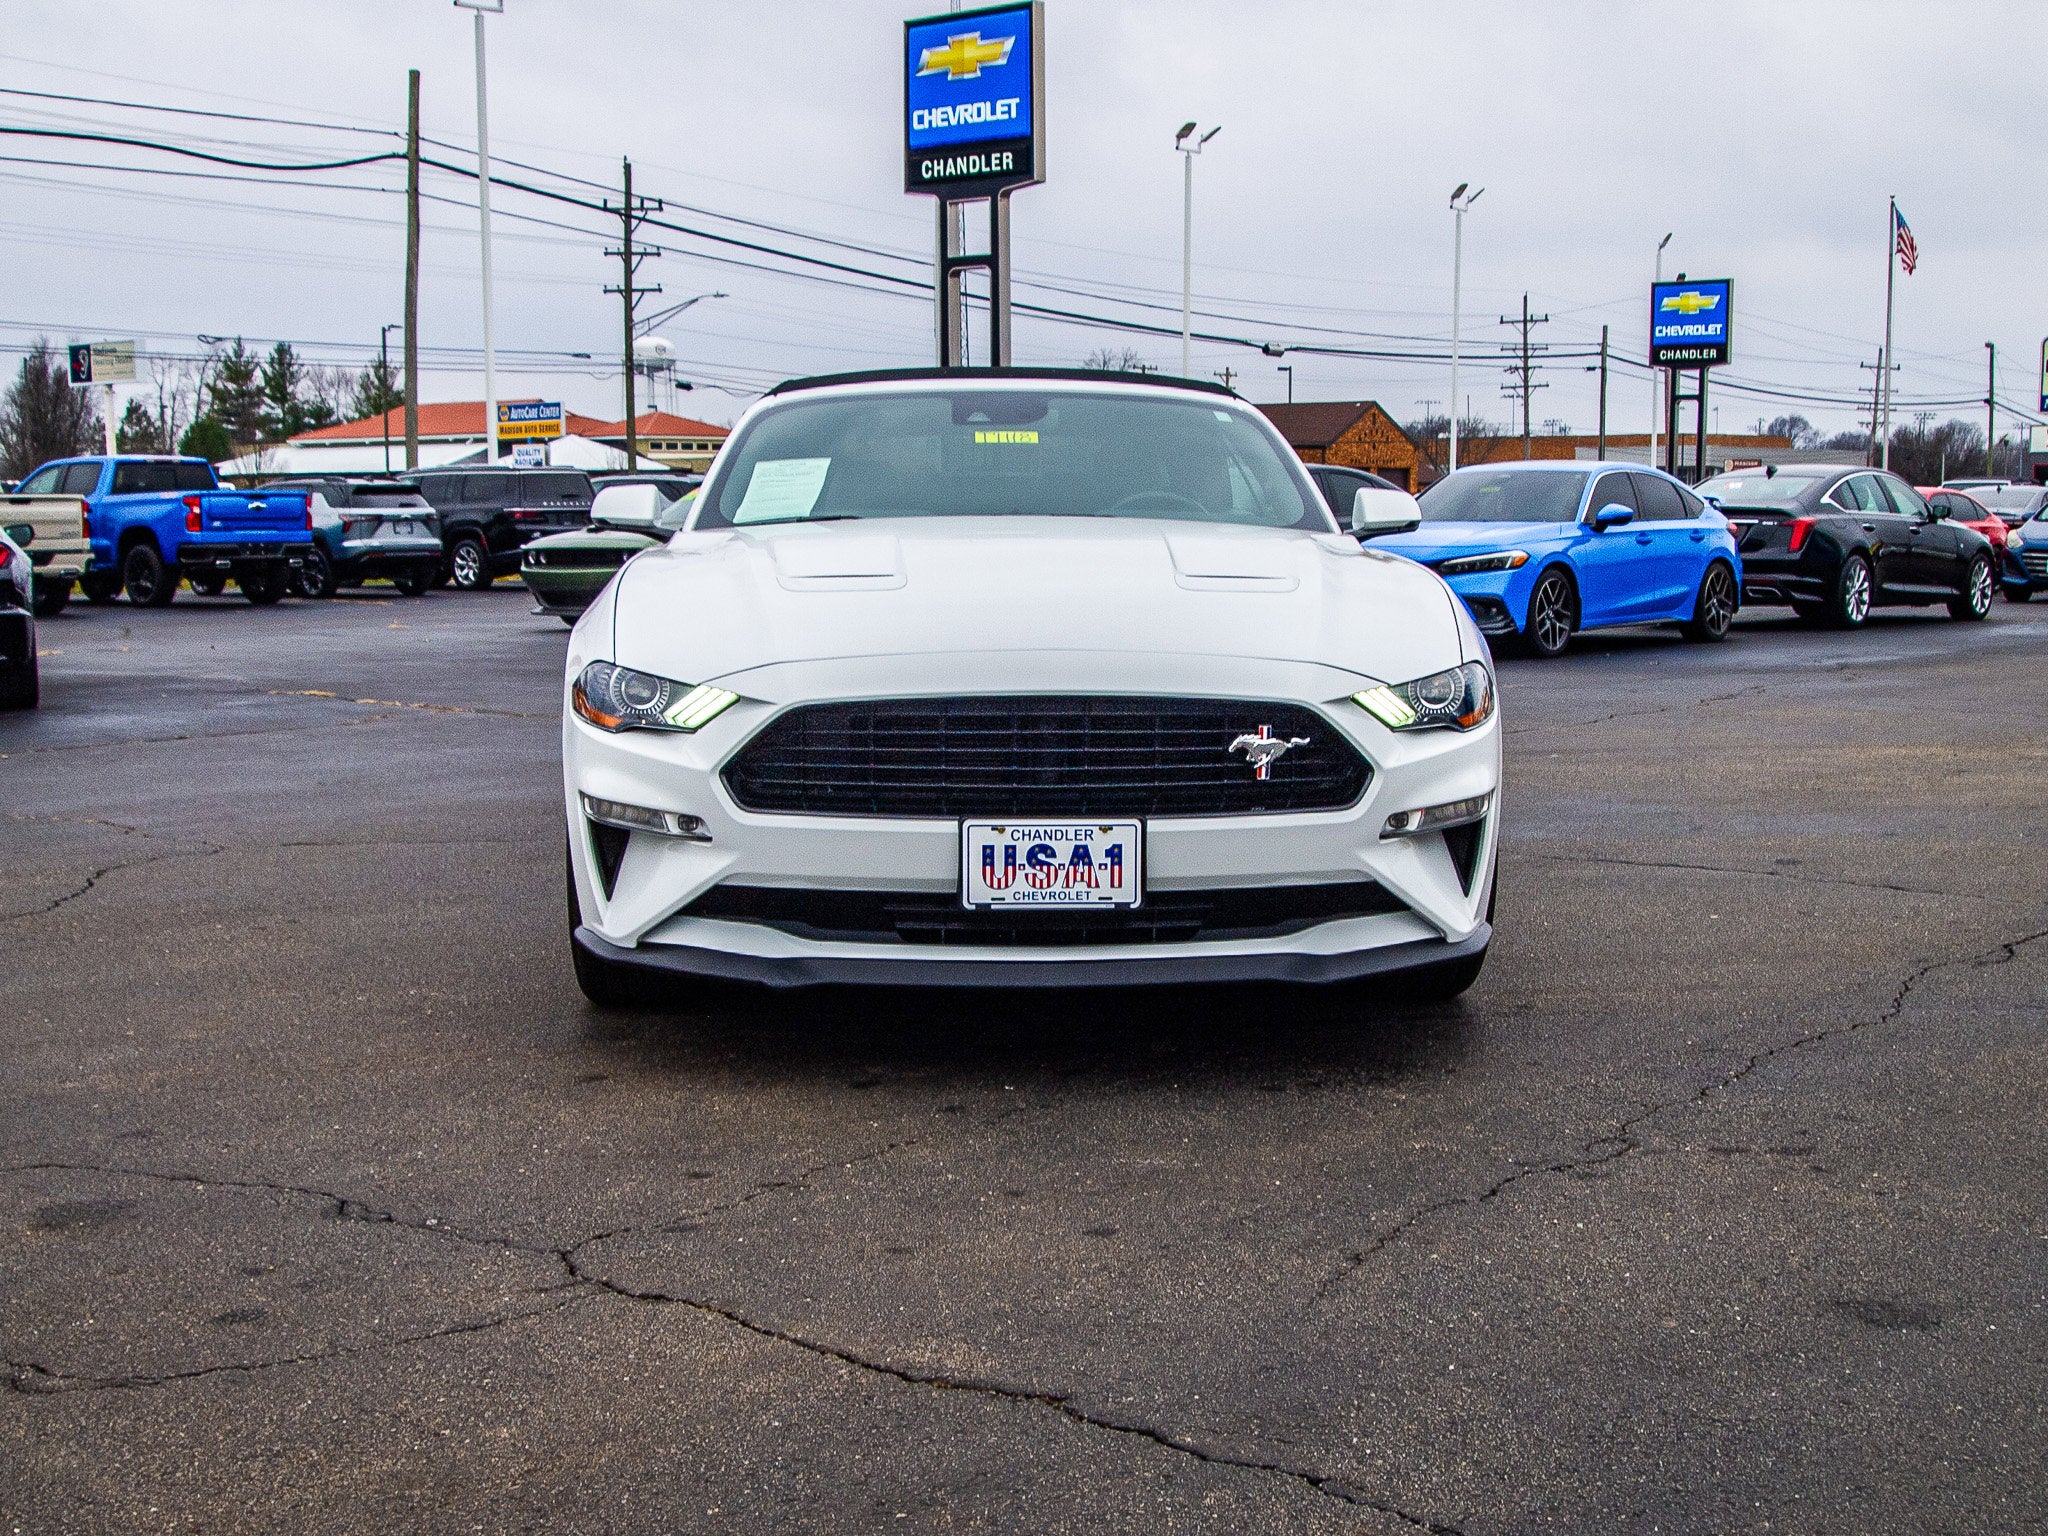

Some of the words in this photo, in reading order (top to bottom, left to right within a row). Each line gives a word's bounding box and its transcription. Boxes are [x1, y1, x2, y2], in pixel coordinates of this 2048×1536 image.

[912, 97, 1020, 131] CHEVROLET
[921, 151, 1014, 179] CHANDLER
[1655, 323, 1723, 337] CHEVROLET
[1659, 348, 1717, 360] CHANDLER
[516, 448, 541, 457] QUALITY
[1010, 828, 1095, 842] CHANDLER
[1012, 890, 1092, 901] CHEVROLET
